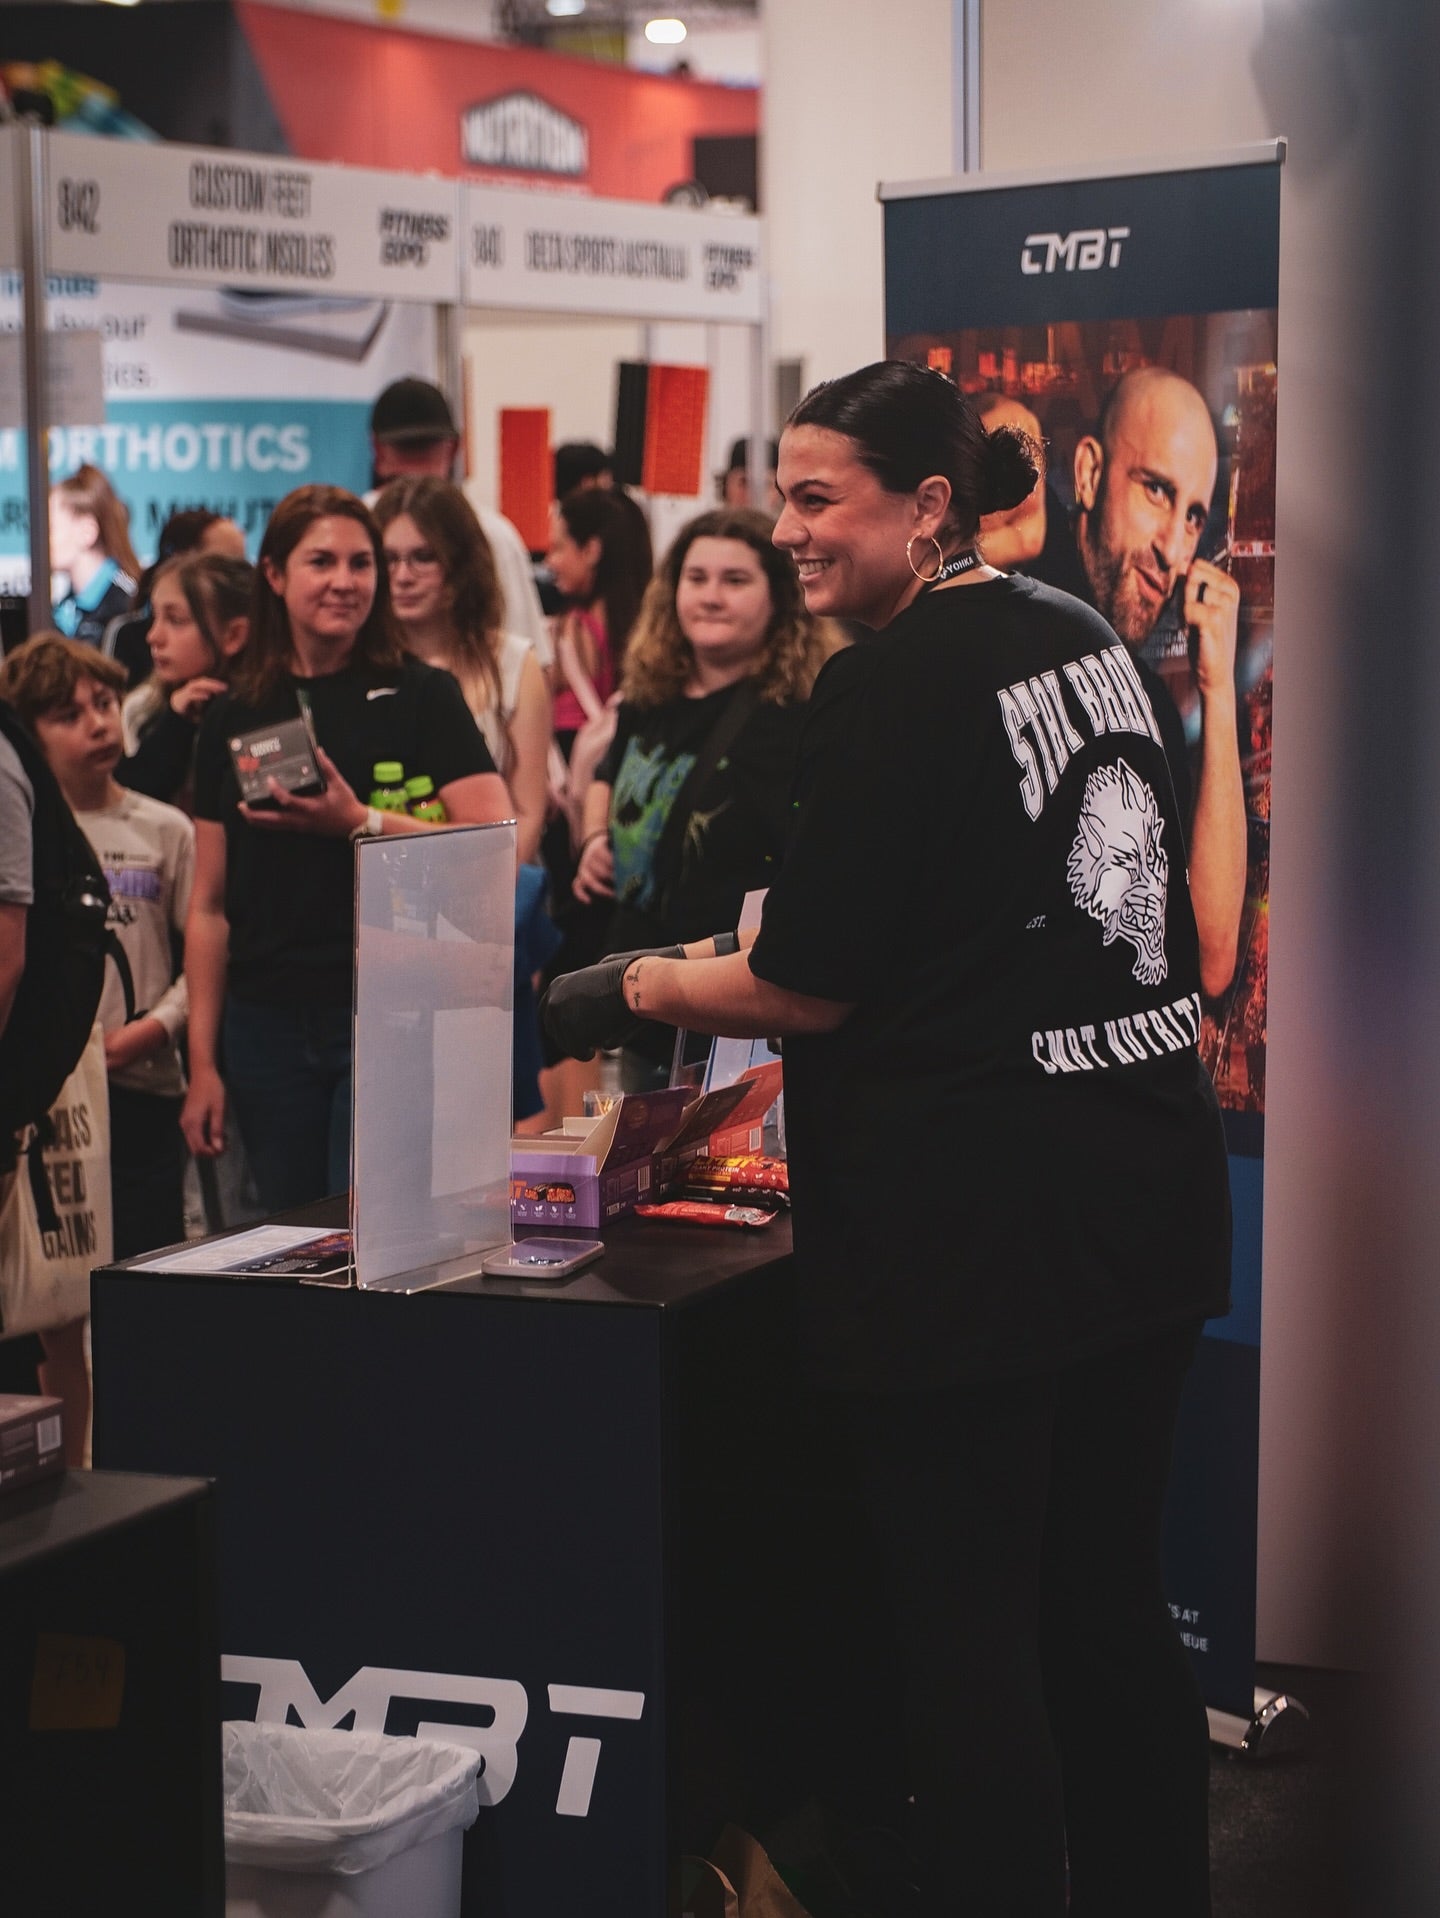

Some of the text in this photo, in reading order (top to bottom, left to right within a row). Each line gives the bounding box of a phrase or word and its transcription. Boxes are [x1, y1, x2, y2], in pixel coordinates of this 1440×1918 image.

[58, 178, 100, 234] 842
[190, 163, 266, 213] CUSTOM
[169, 220, 258, 274] ORTHOTIC
[1021, 227, 1131, 275] CMBT
[221, 1654, 645, 1817] MBT
